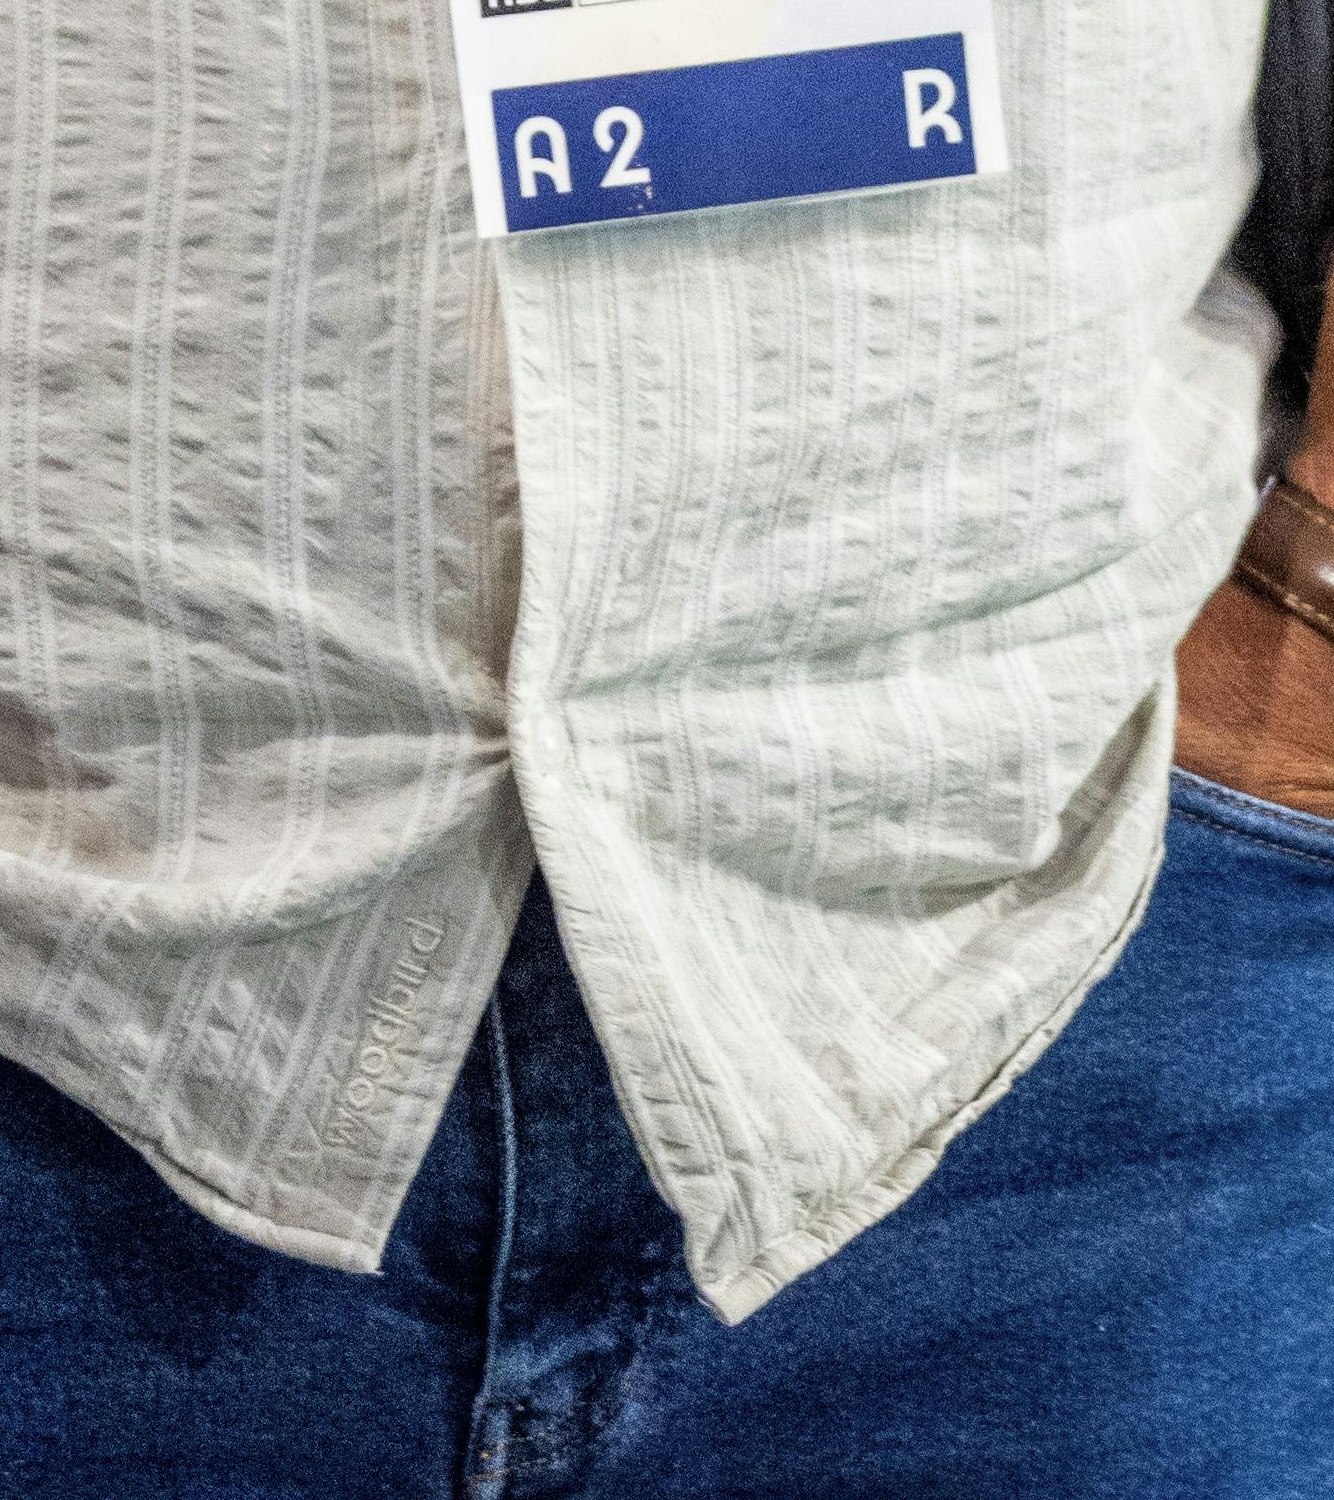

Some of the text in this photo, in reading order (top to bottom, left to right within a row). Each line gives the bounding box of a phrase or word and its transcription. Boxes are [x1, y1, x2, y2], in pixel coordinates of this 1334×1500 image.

[513, 67, 964, 199] A 2 R
[321, 915, 444, 1148] woodbird
